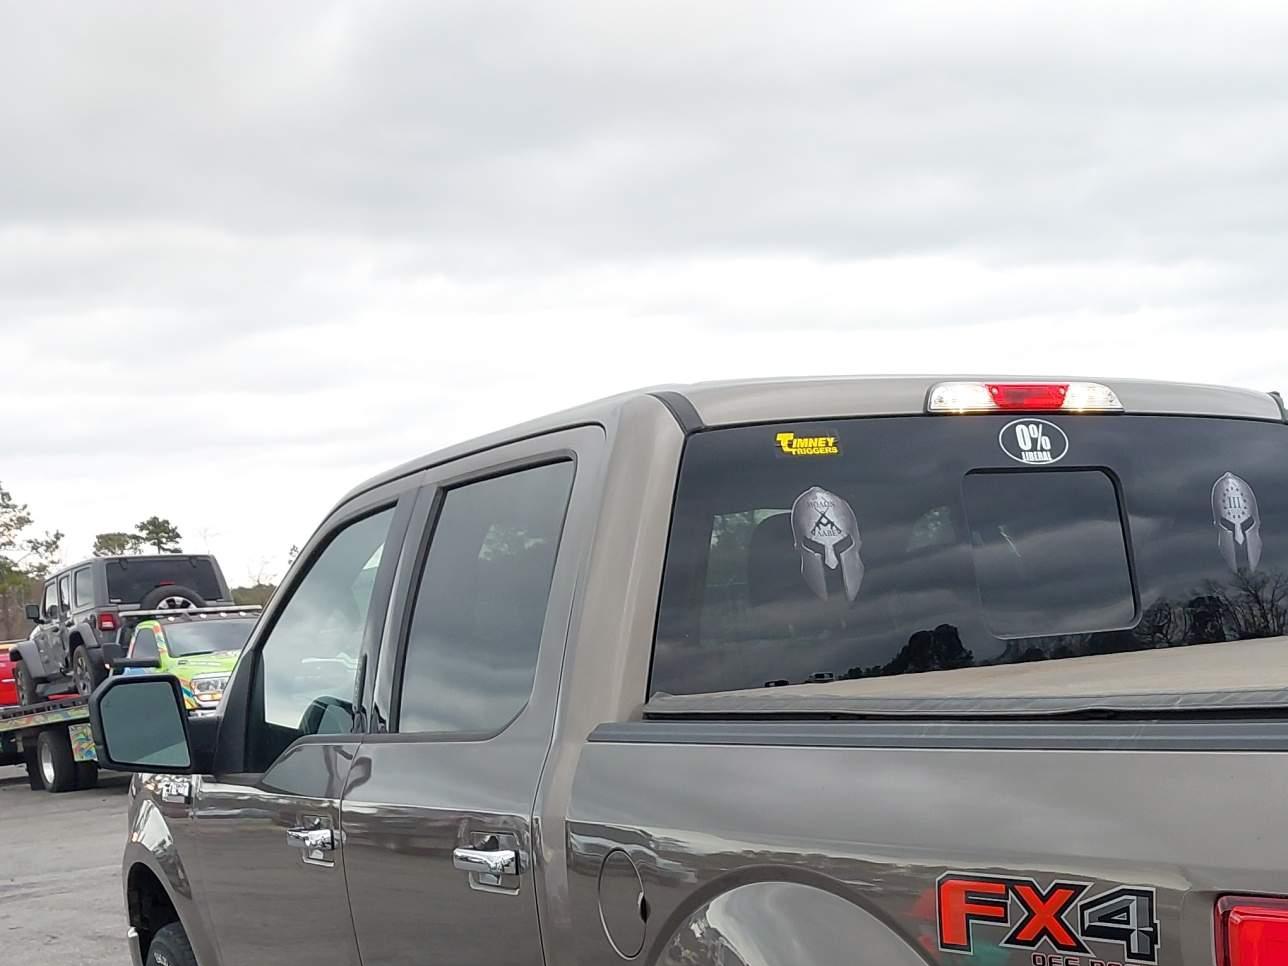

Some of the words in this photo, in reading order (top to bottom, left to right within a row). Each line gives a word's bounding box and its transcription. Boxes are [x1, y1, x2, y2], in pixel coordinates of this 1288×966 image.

[776, 432, 836, 452] TIMNEY
[1015, 423, 1052, 451] 0%
[791, 446, 839, 456] TRIGGERS
[1020, 450, 1053, 461] LIBERAL
[936, 870, 1160, 965] FX4
